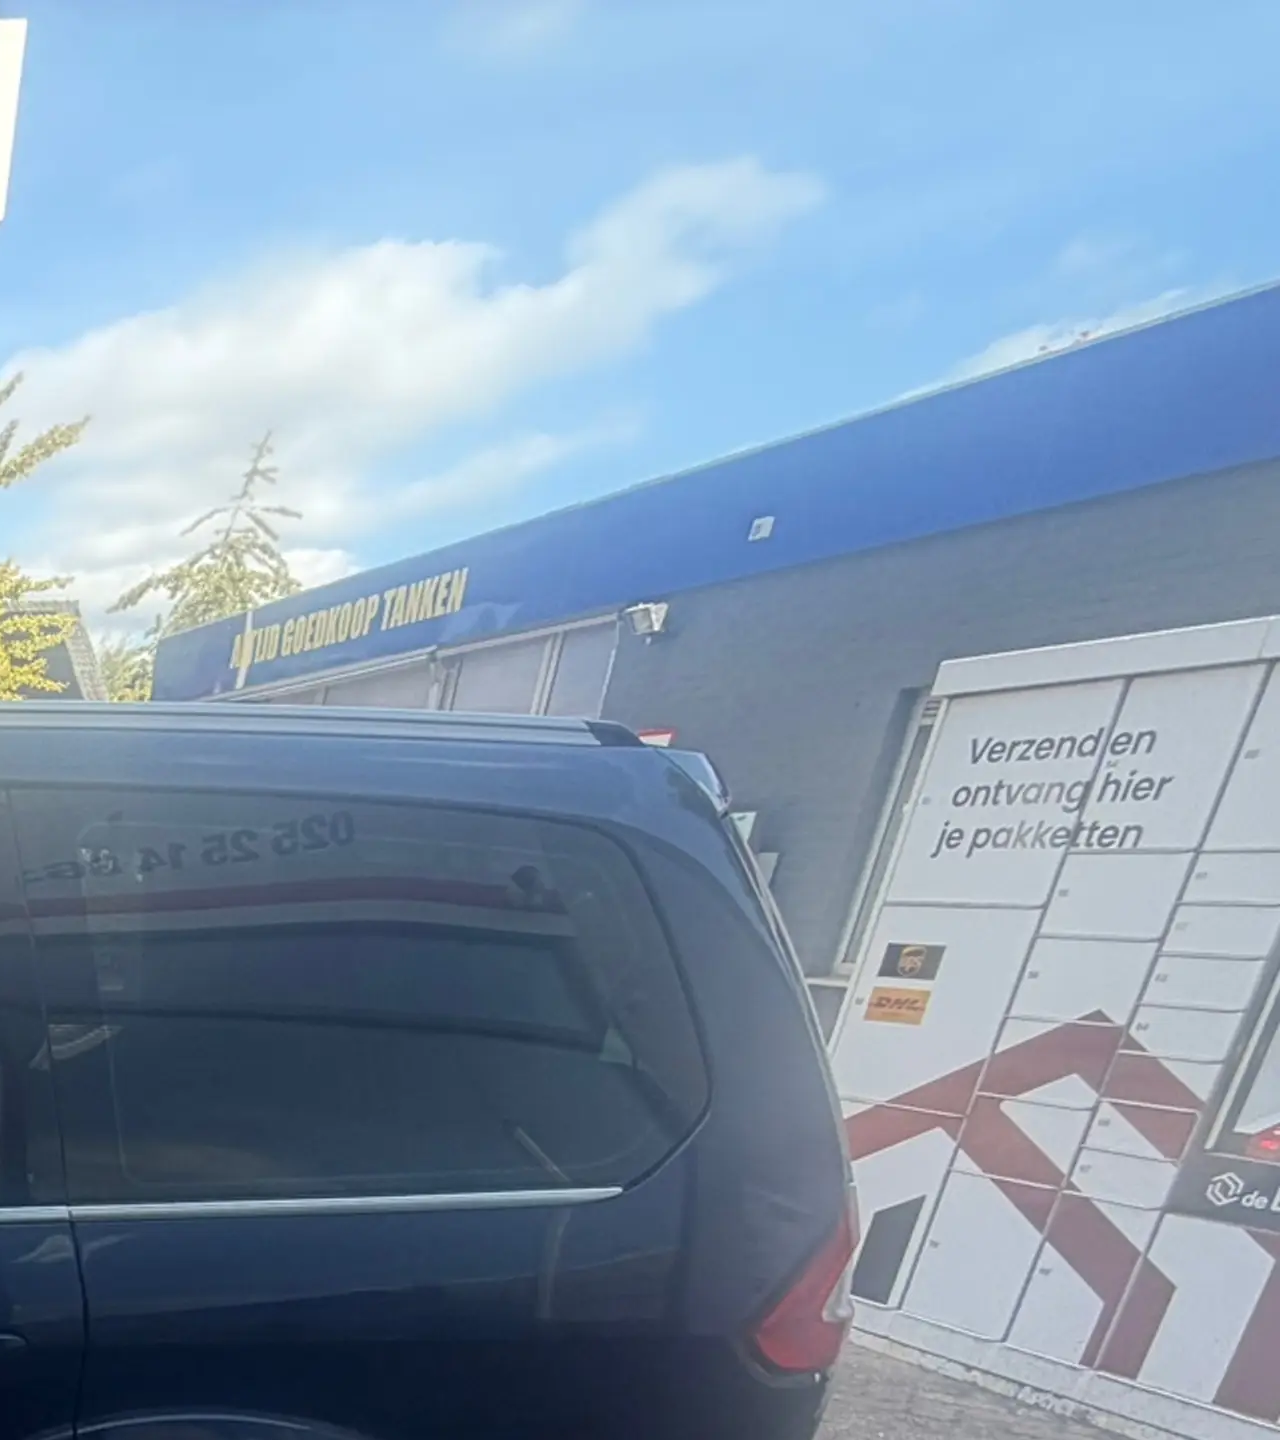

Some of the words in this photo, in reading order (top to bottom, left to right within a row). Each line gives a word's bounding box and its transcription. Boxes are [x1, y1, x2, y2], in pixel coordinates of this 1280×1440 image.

[230, 622, 281, 669] ATIJD
[280, 593, 380, 657] GOEDKOOP
[380, 567, 469, 631] TANKEN
[970, 727, 1104, 764] Verzend
[1109, 729, 1157, 756] en
[952, 779, 1092, 813] ontvang
[1097, 769, 1175, 803] hier
[930, 820, 965, 858] je
[966, 820, 1144, 858] pakketten
[873, 996, 925, 1011] DHL
[1242, 1190, 1268, 1209] de
